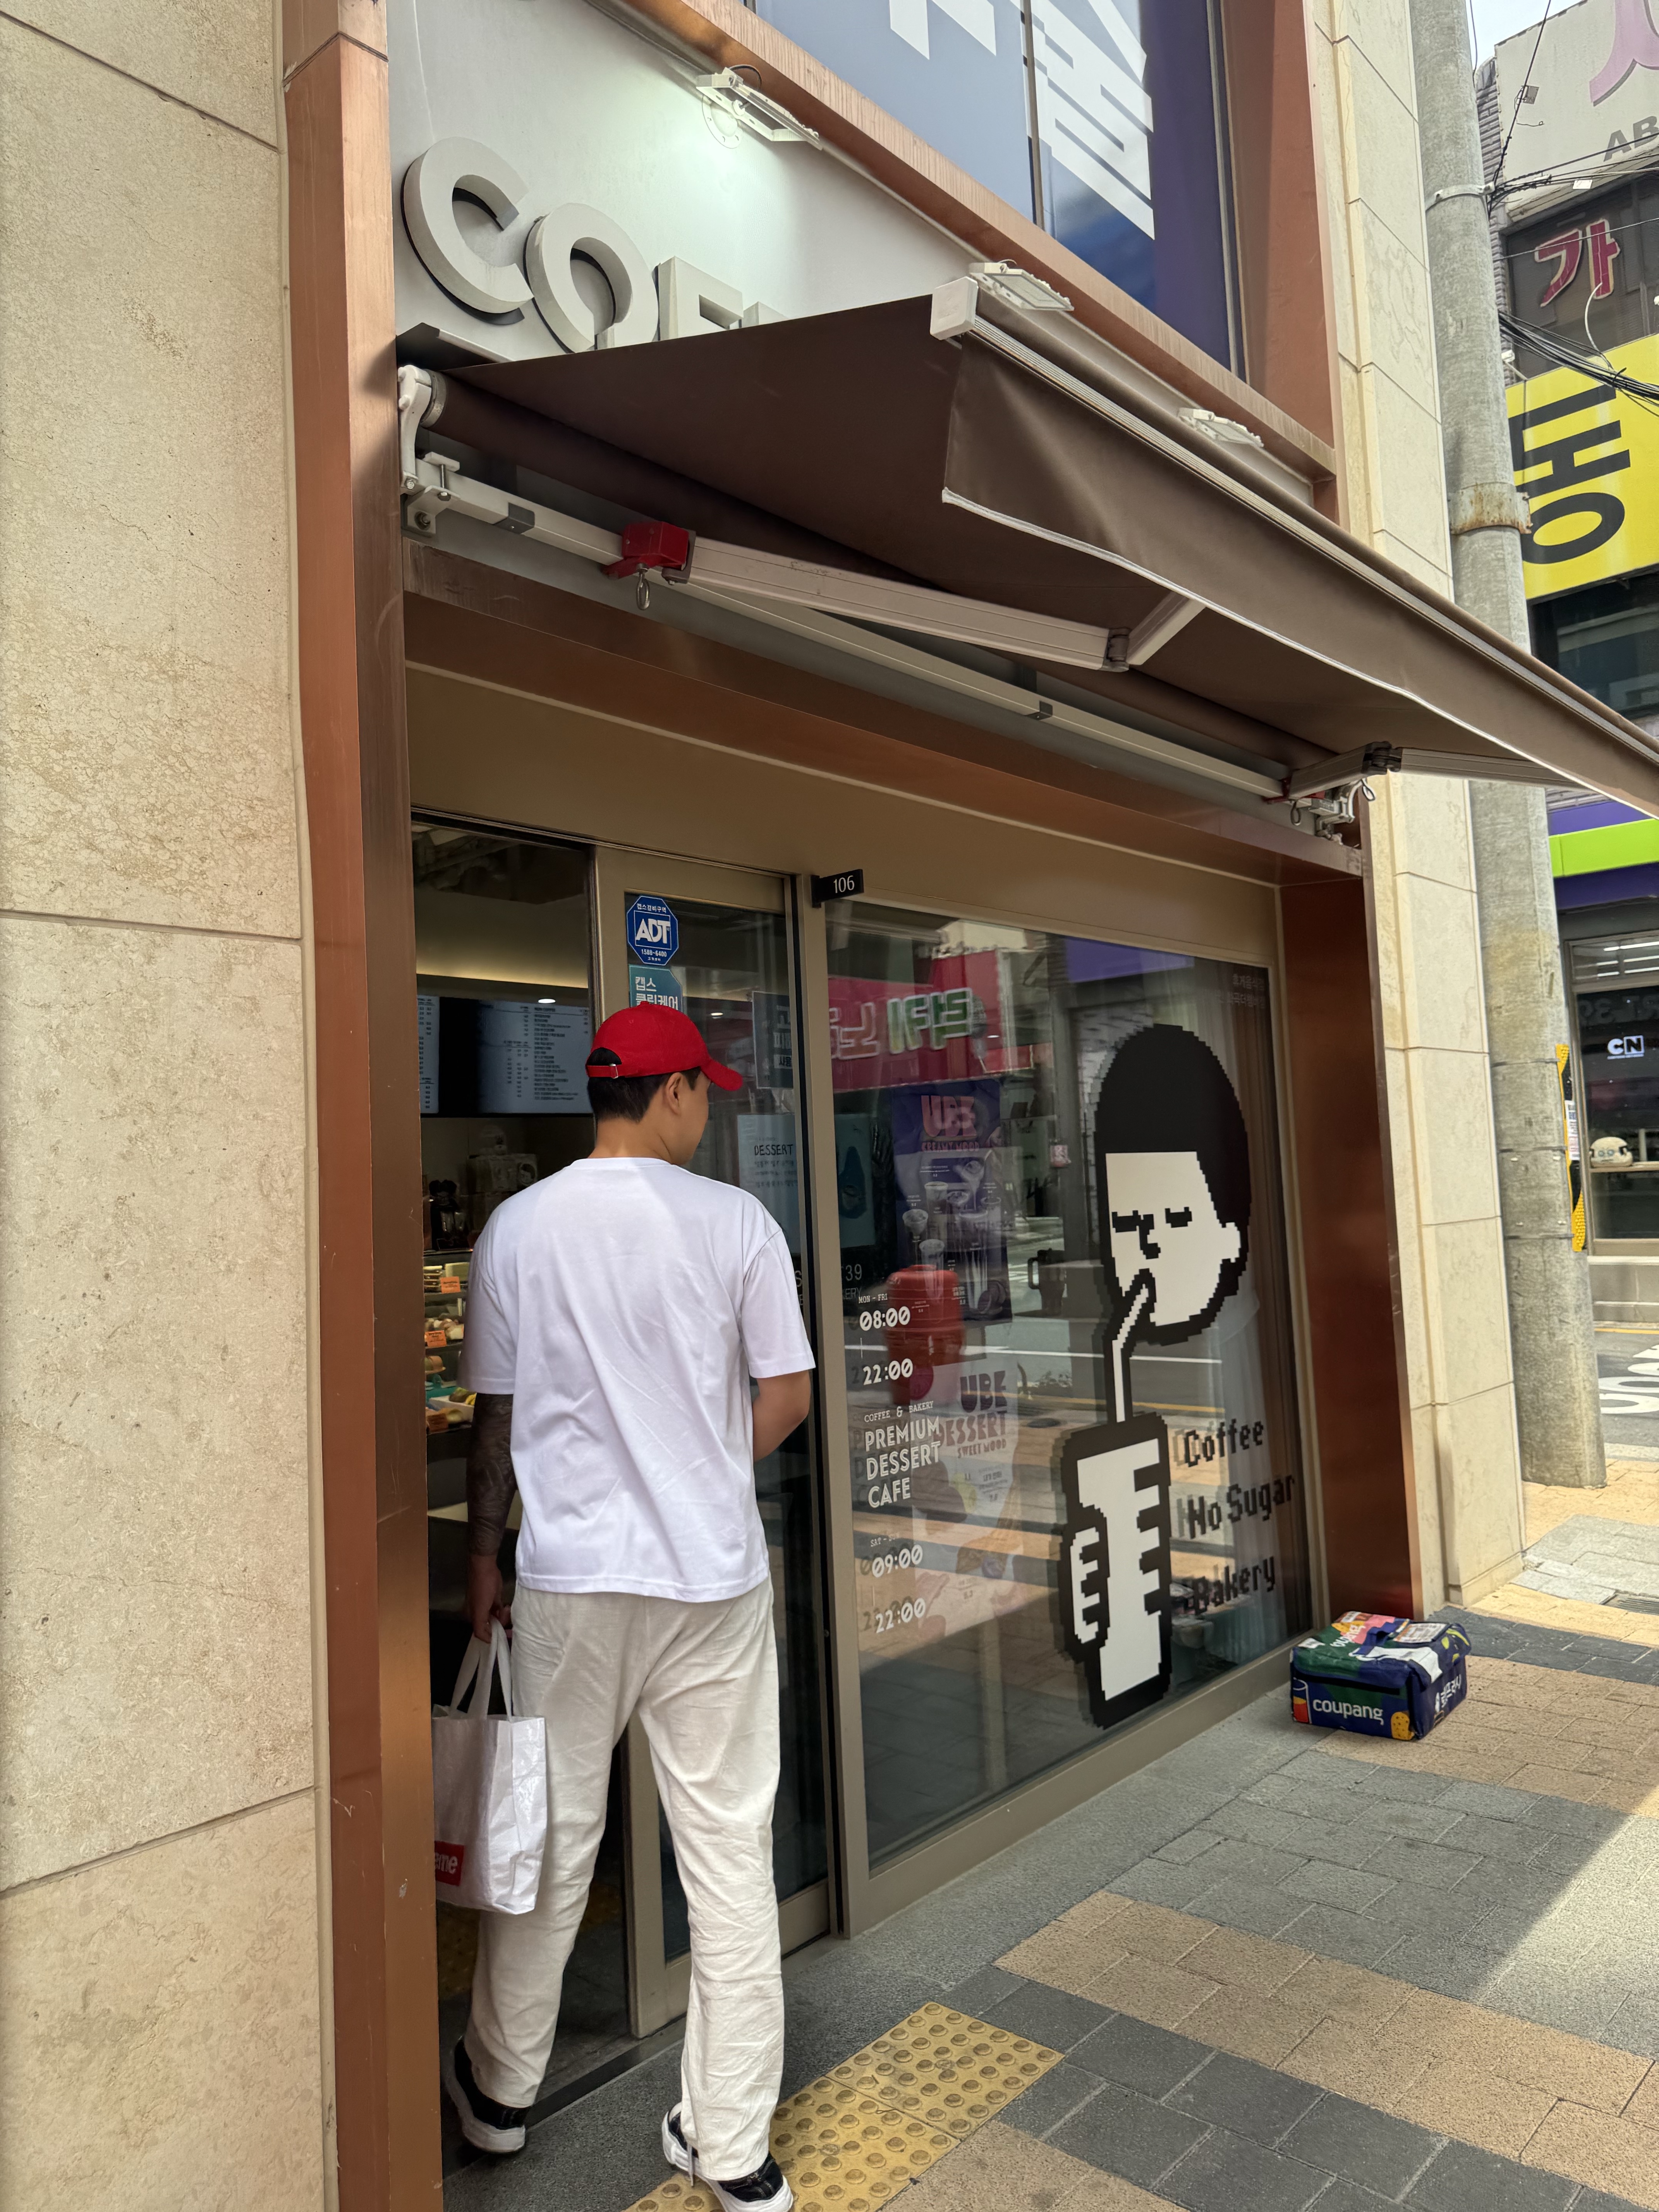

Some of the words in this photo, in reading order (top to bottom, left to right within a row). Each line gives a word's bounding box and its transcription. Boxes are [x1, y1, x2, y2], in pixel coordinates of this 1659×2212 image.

[1534, 218, 1620, 307] 가
[833, 875, 855, 893] 106
[635, 918, 671, 944] ADT
[635, 976, 657, 991] 캡스
[1607, 1035, 1645, 1054] CN
[755, 1144, 793, 1156] DESSERT
[956, 1142, 979, 1152] MOOD
[859, 1295, 870, 1304] MON
[859, 1306, 910, 1331] 08:00
[863, 1358, 913, 1385] 22:00
[960, 1370, 1007, 1413] UBE
[864, 1410, 890, 1422] COFFEE
[896, 1406, 903, 1417] &
[909, 1401, 933, 1413] BAKERY
[865, 1416, 941, 1452] PREMIUM
[933, 1410, 1008, 1448] DESSERT
[958, 1443, 981, 1458] SWEET
[984, 1439, 1006, 1453] MOOD
[1185, 1419, 1264, 1467] Coffee
[866, 1441, 941, 1480] DESSERT
[868, 1477, 911, 1508] CAFE
[1188, 1496, 1221, 1539] No
[1227, 1475, 1295, 1522] Sugar
[872, 1544, 923, 1577] 09:00
[1192, 1556, 1276, 1614] Bakery
[876, 1598, 926, 1633] 22:00
[1313, 1699, 1383, 1725] coupang
